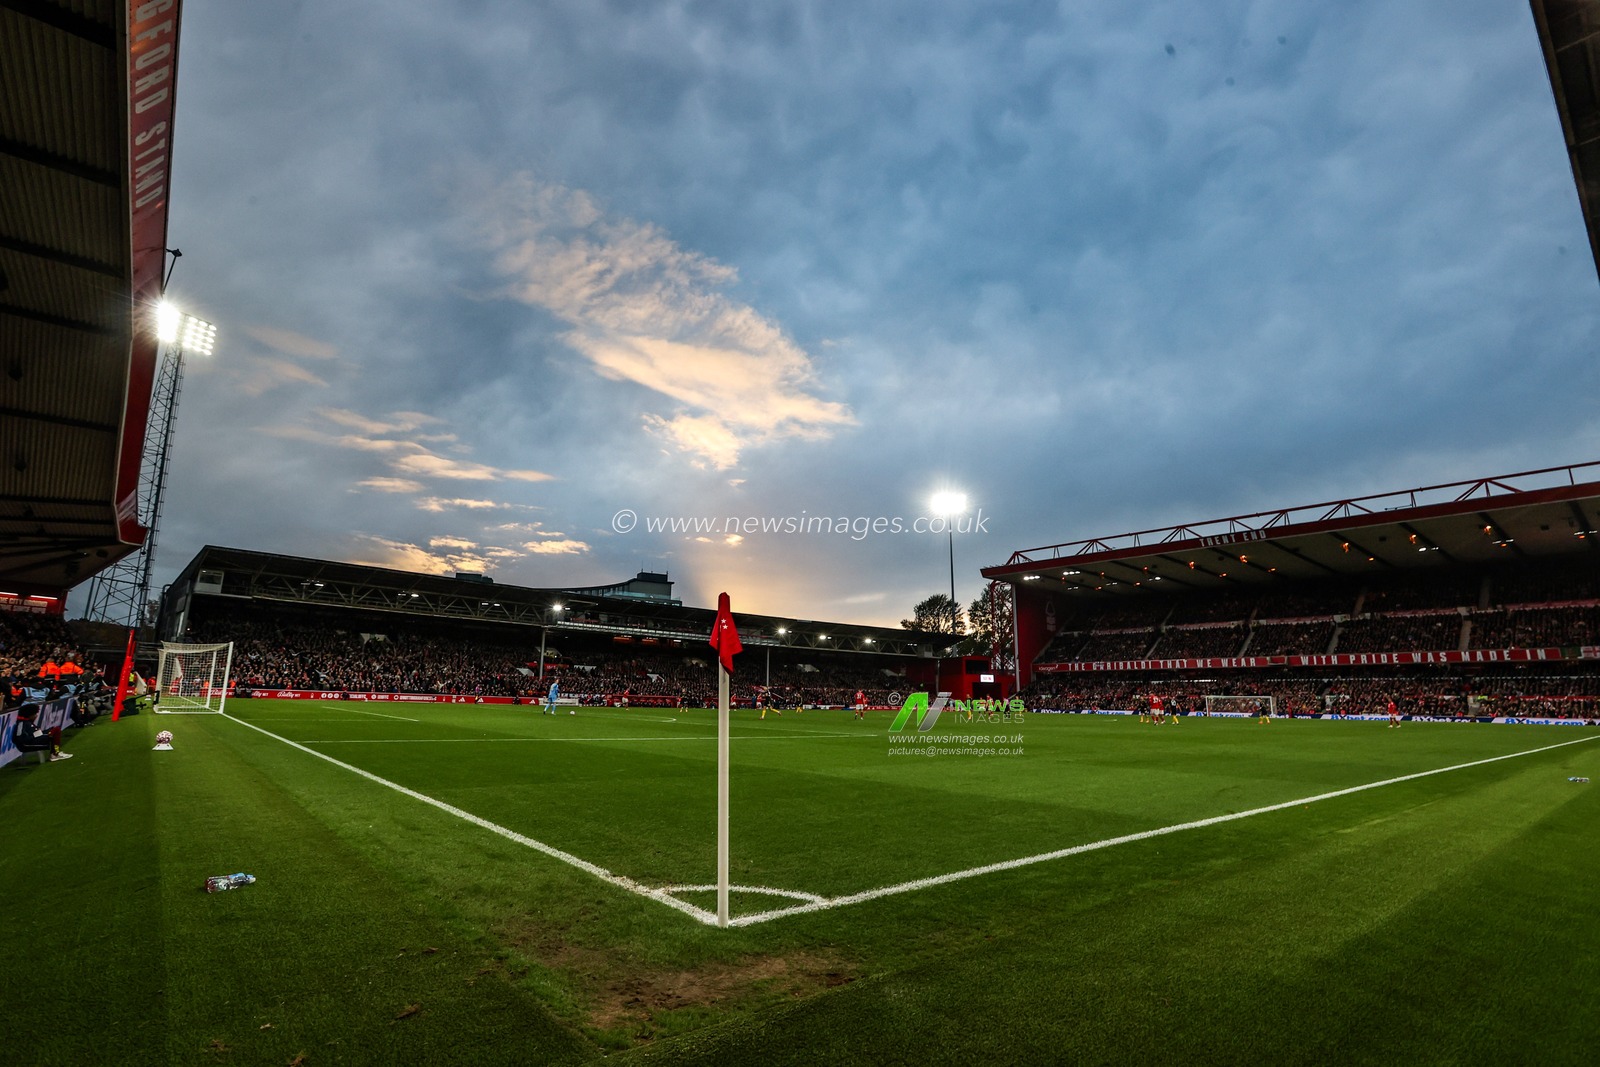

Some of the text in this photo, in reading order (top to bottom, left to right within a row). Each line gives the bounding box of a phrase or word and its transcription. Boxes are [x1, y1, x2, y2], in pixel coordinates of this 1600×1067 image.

[135, 121, 166, 208] STAND
[1200, 530, 1267, 547] TRENT END
[1068, 663, 1085, 671] THE
[1159, 659, 1187, 669] THAT
[1196, 658, 1212, 668] WE
[1221, 657, 1256, 667] WEAR
[1300, 655, 1338, 665] WITH
[1349, 653, 1399, 664] PRIDE
[1411, 652, 1447, 663] WAS
[1461, 650, 1511, 662] MADE
[1526, 649, 1547, 660] IN
[1505, 718, 1584, 726] 8Xbetcom
